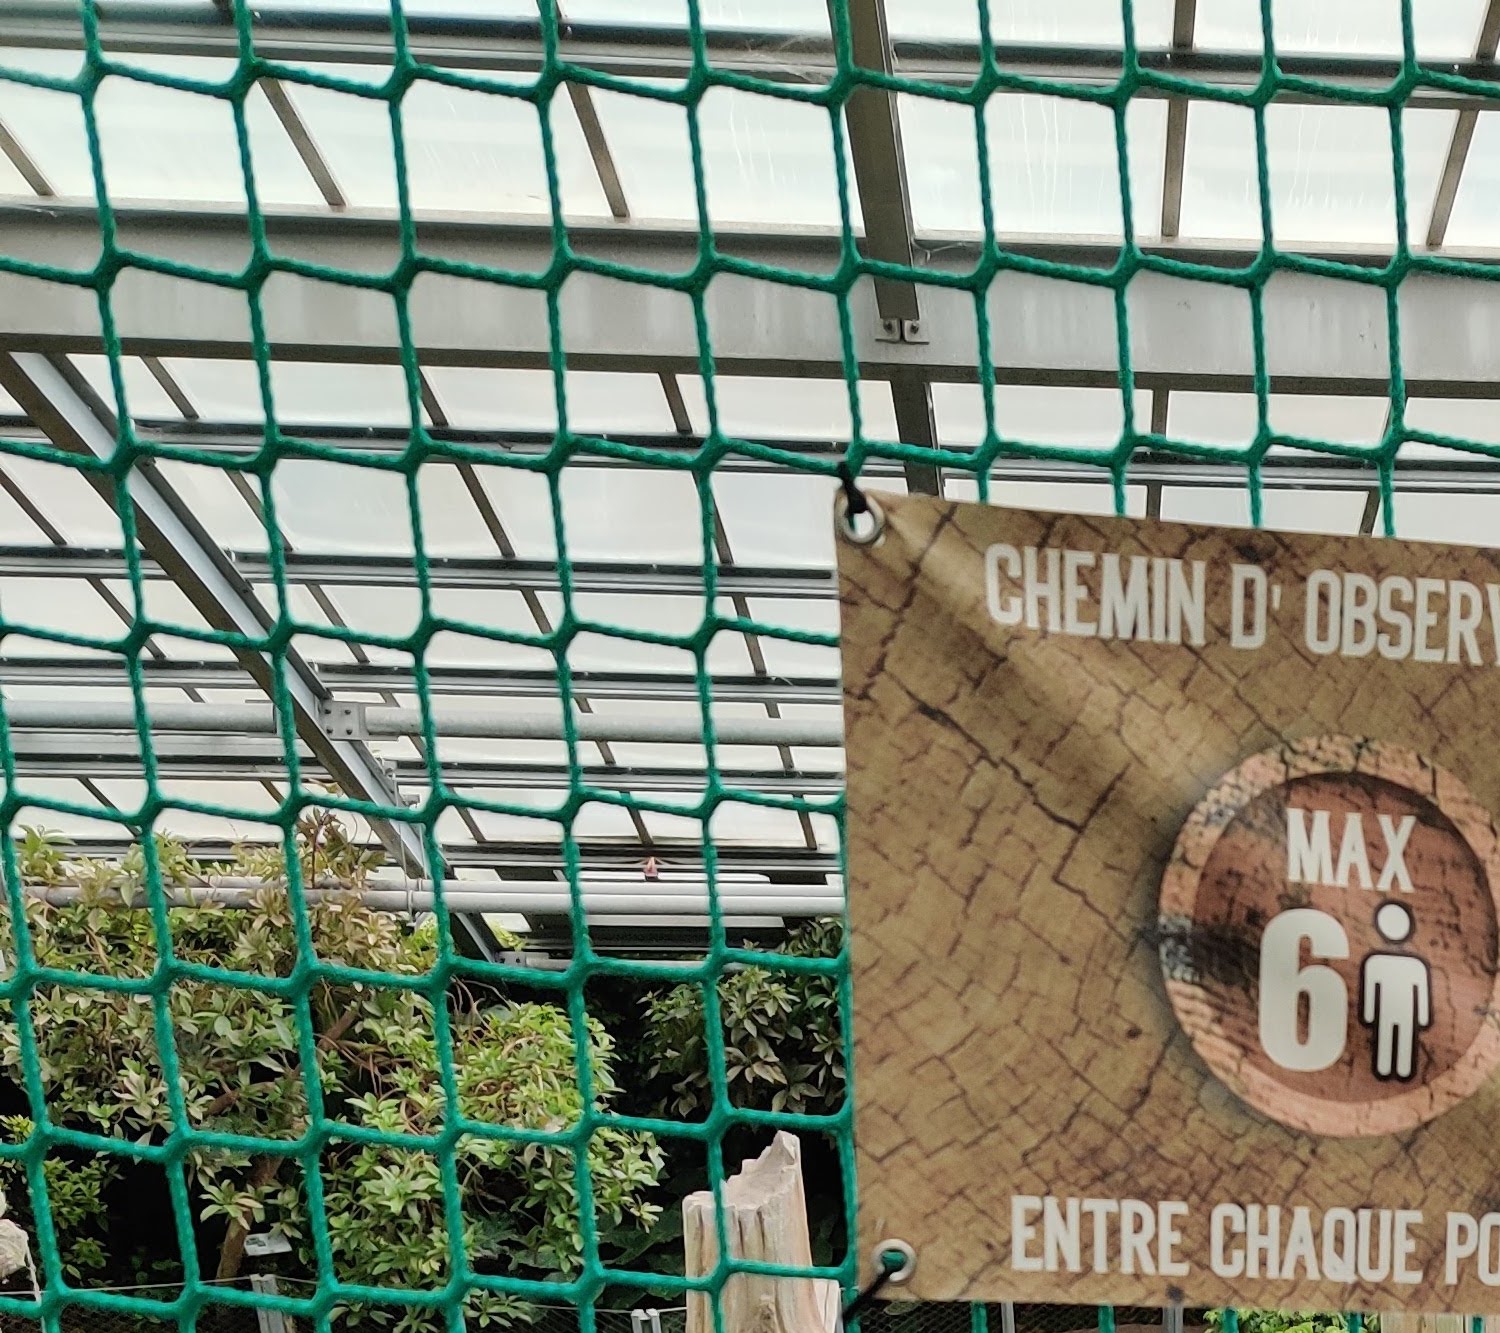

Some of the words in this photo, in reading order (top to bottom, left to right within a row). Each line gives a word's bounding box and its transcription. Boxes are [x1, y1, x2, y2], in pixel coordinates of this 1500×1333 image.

[985, 543, 1206, 647] CHEMIN
[1230, 563, 1281, 649] D'
[1286, 808, 1417, 893] MAX
[1258, 908, 1350, 1073] 6
[1010, 1194, 1190, 1277] ENTRE
[1210, 1202, 1424, 1285] CHAQUE
